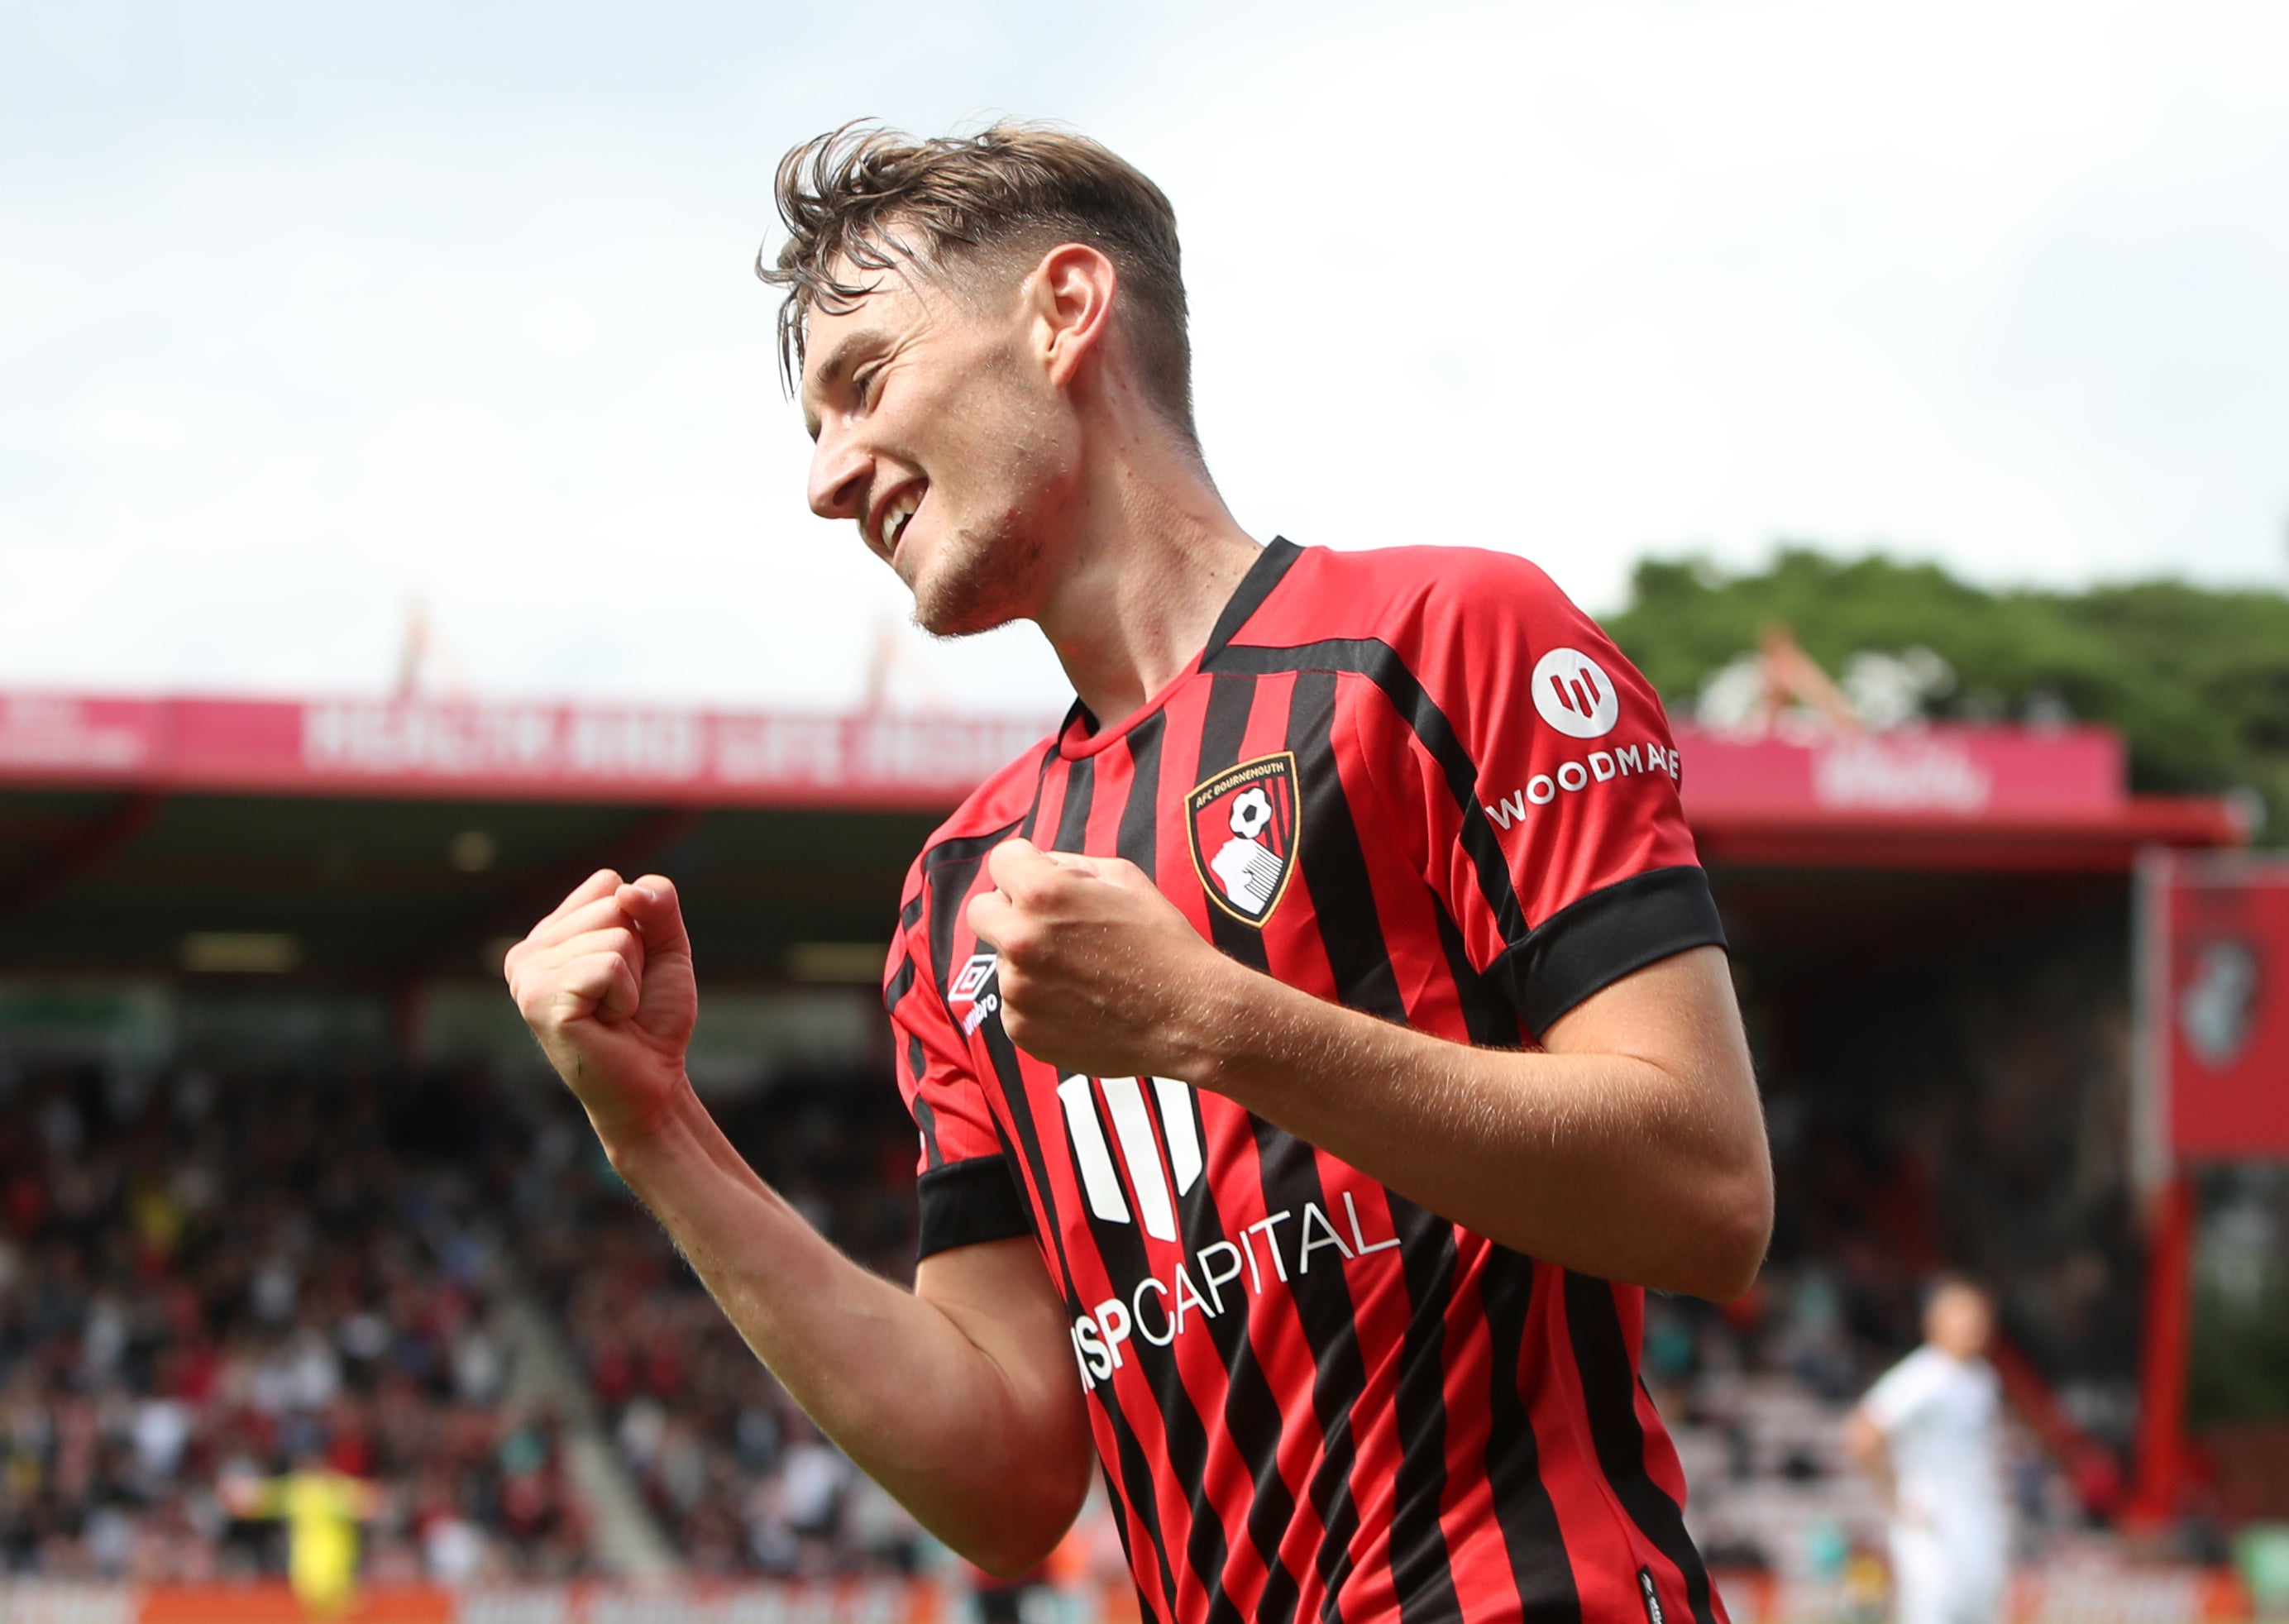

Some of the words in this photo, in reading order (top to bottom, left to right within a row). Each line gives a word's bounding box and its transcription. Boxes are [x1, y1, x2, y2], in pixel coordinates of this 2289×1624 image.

[1196, 790, 1212, 808] AFC
[1214, 762, 1284, 795] BOURNEMOUTH
[963, 993, 997, 1036] umbro
